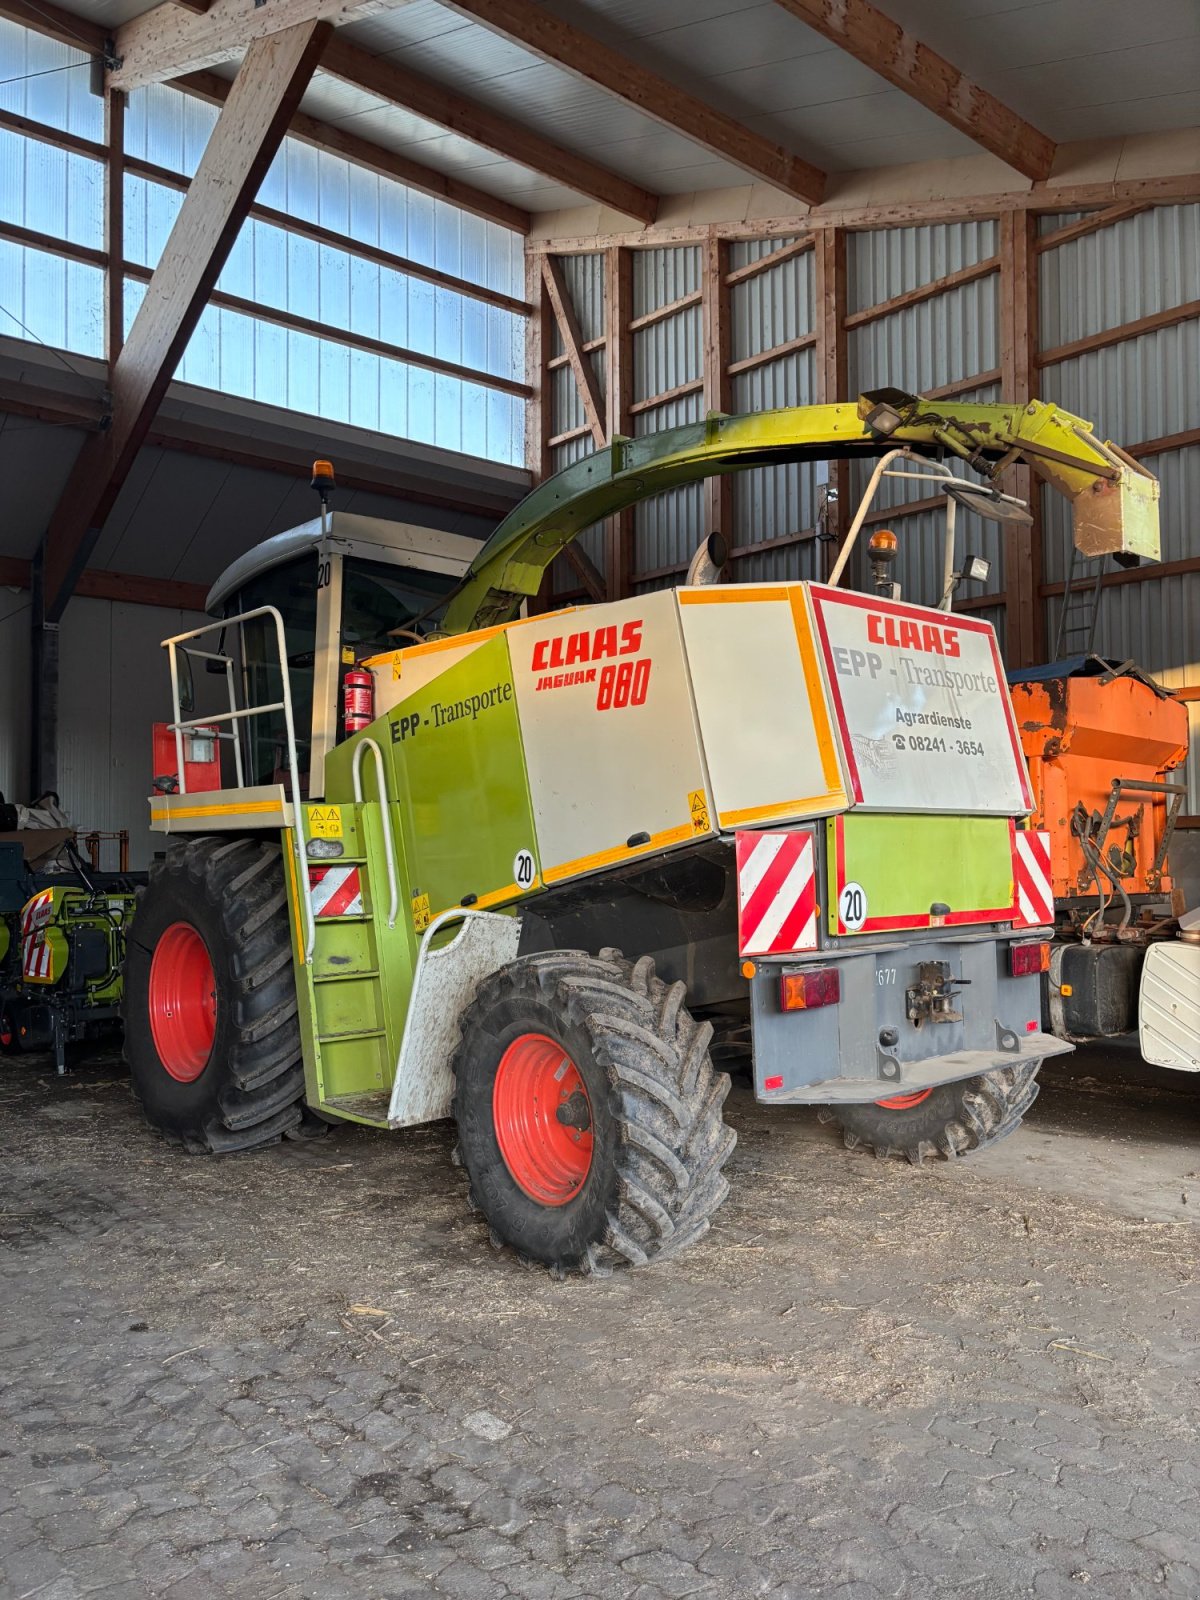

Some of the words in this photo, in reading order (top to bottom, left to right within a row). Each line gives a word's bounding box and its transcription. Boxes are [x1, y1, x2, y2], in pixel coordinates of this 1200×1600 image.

[317, 561, 331, 589] 20
[531, 620, 643, 671] CLAAS
[867, 614, 961, 657] CLAAS
[536, 668, 597, 691] JAGUAR
[597, 659, 651, 711] 880
[832, 646, 882, 679] EPP
[899, 657, 997, 697] Transporte
[390, 713, 420, 744] EPP
[431, 682, 512, 727] Transporte
[896, 708, 972, 729] Agrardienste
[909, 736, 946, 752] 08241
[956, 740, 984, 756] 3654
[518, 855, 532, 883] 20
[845, 890, 862, 921] 20
